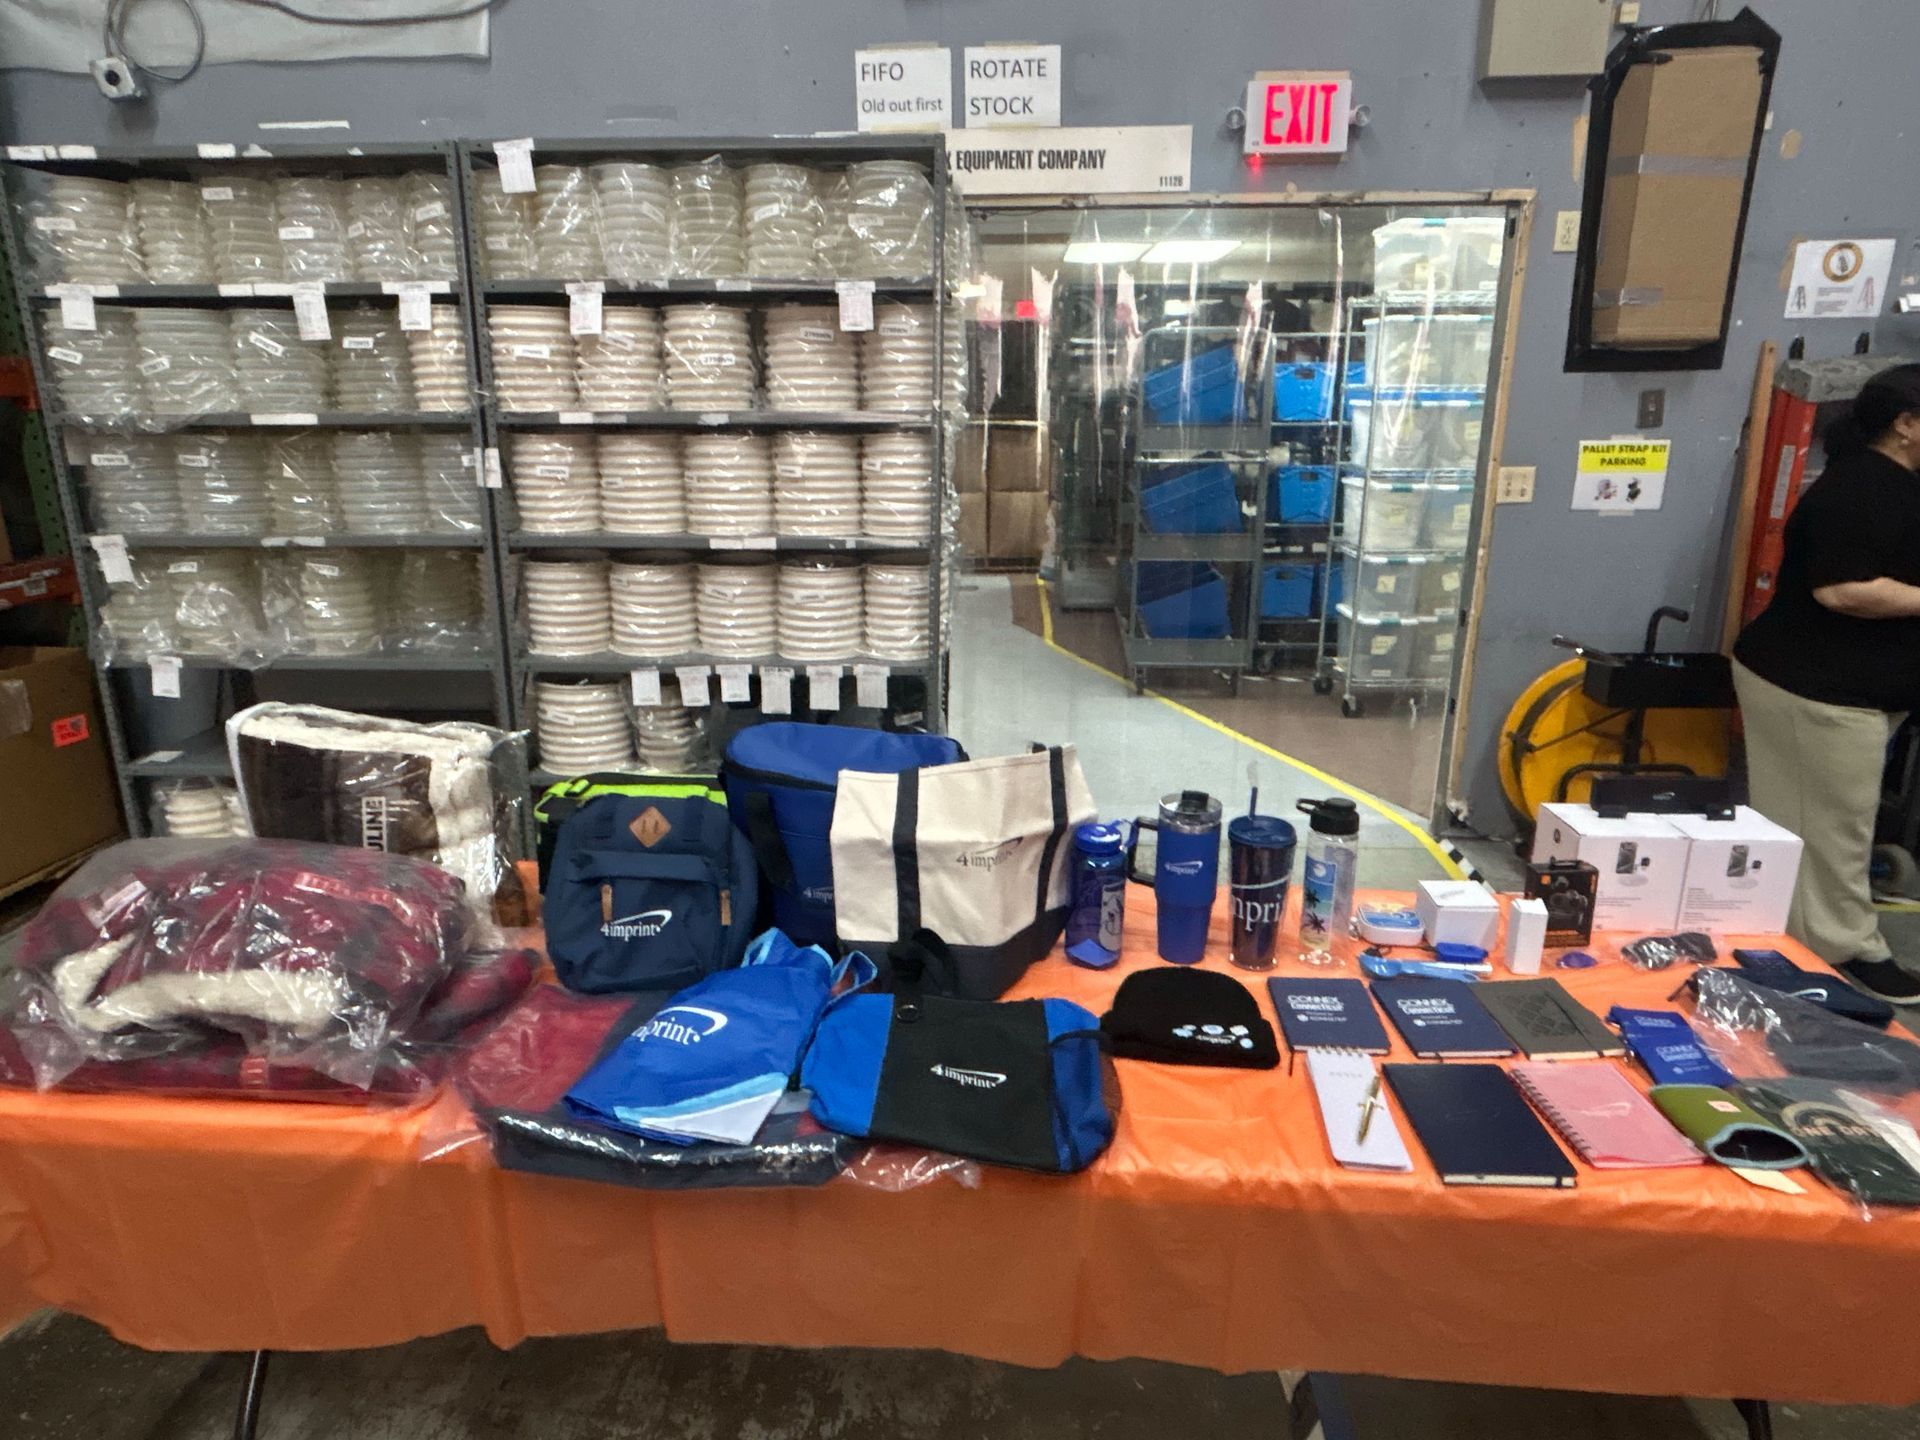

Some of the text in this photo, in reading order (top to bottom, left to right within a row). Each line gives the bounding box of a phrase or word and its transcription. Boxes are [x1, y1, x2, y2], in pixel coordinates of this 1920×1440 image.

[861, 63, 904, 82] FIFO
[970, 59, 1047, 79] ROTATE
[862, 98, 943, 113] Old out first
[970, 97, 1033, 116] STOCK
[1264, 84, 1338, 145] EXIT
[956, 150, 1033, 170] EQUIPMENT
[1038, 149, 1106, 170] COMPANY
[1583, 444, 1667, 453] PALLET STRAP KIT
[1600, 458, 1646, 466] PARKING
[600, 922, 657, 942] 4imprint
[930, 1064, 991, 1088] 4imprint
